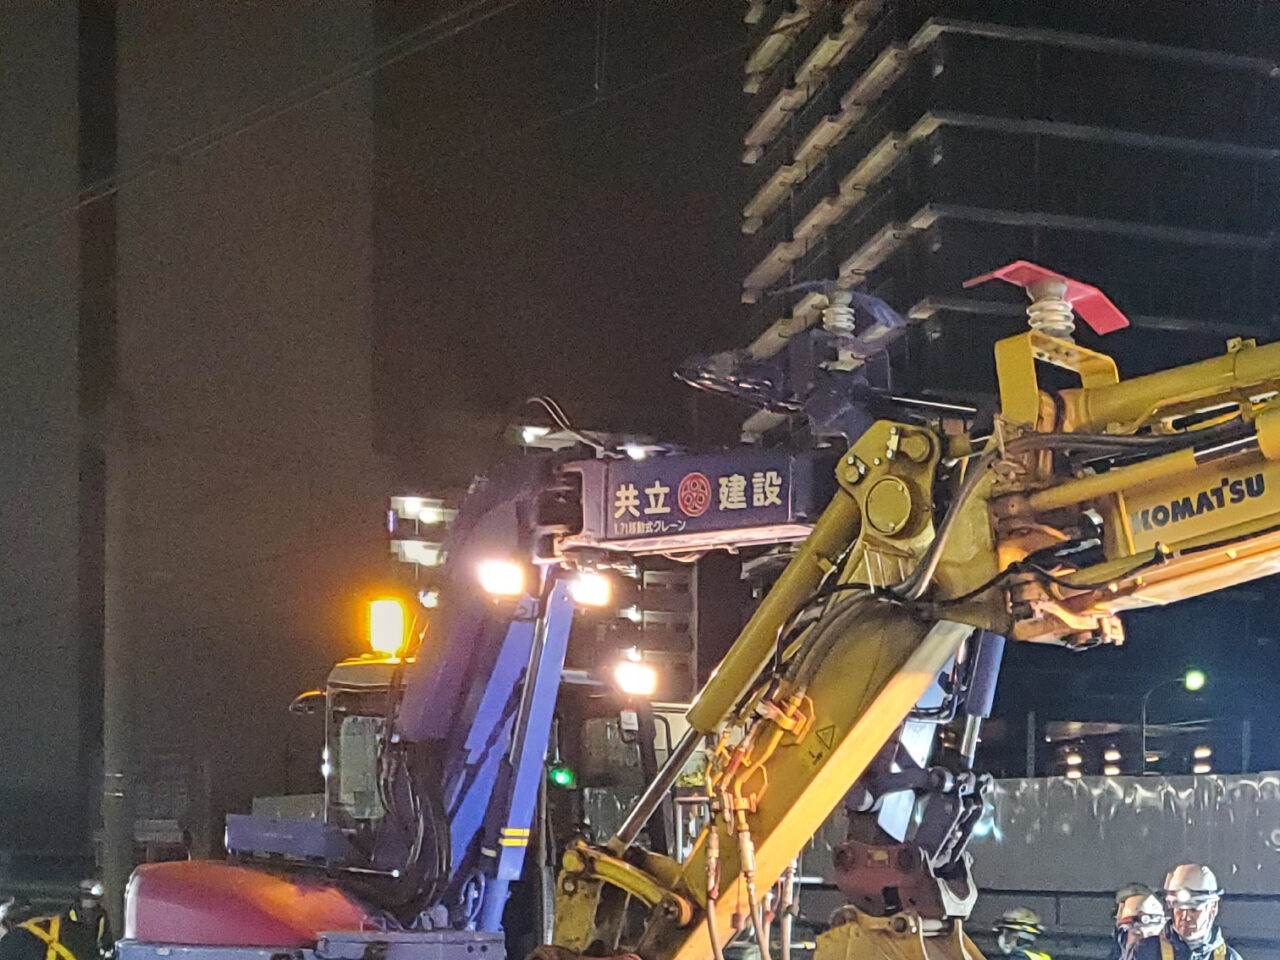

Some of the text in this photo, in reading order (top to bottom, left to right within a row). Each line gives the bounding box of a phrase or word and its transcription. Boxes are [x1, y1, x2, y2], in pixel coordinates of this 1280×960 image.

[614, 470, 783, 519] 共立 建設
[1130, 473, 1266, 536] KOMATSU
